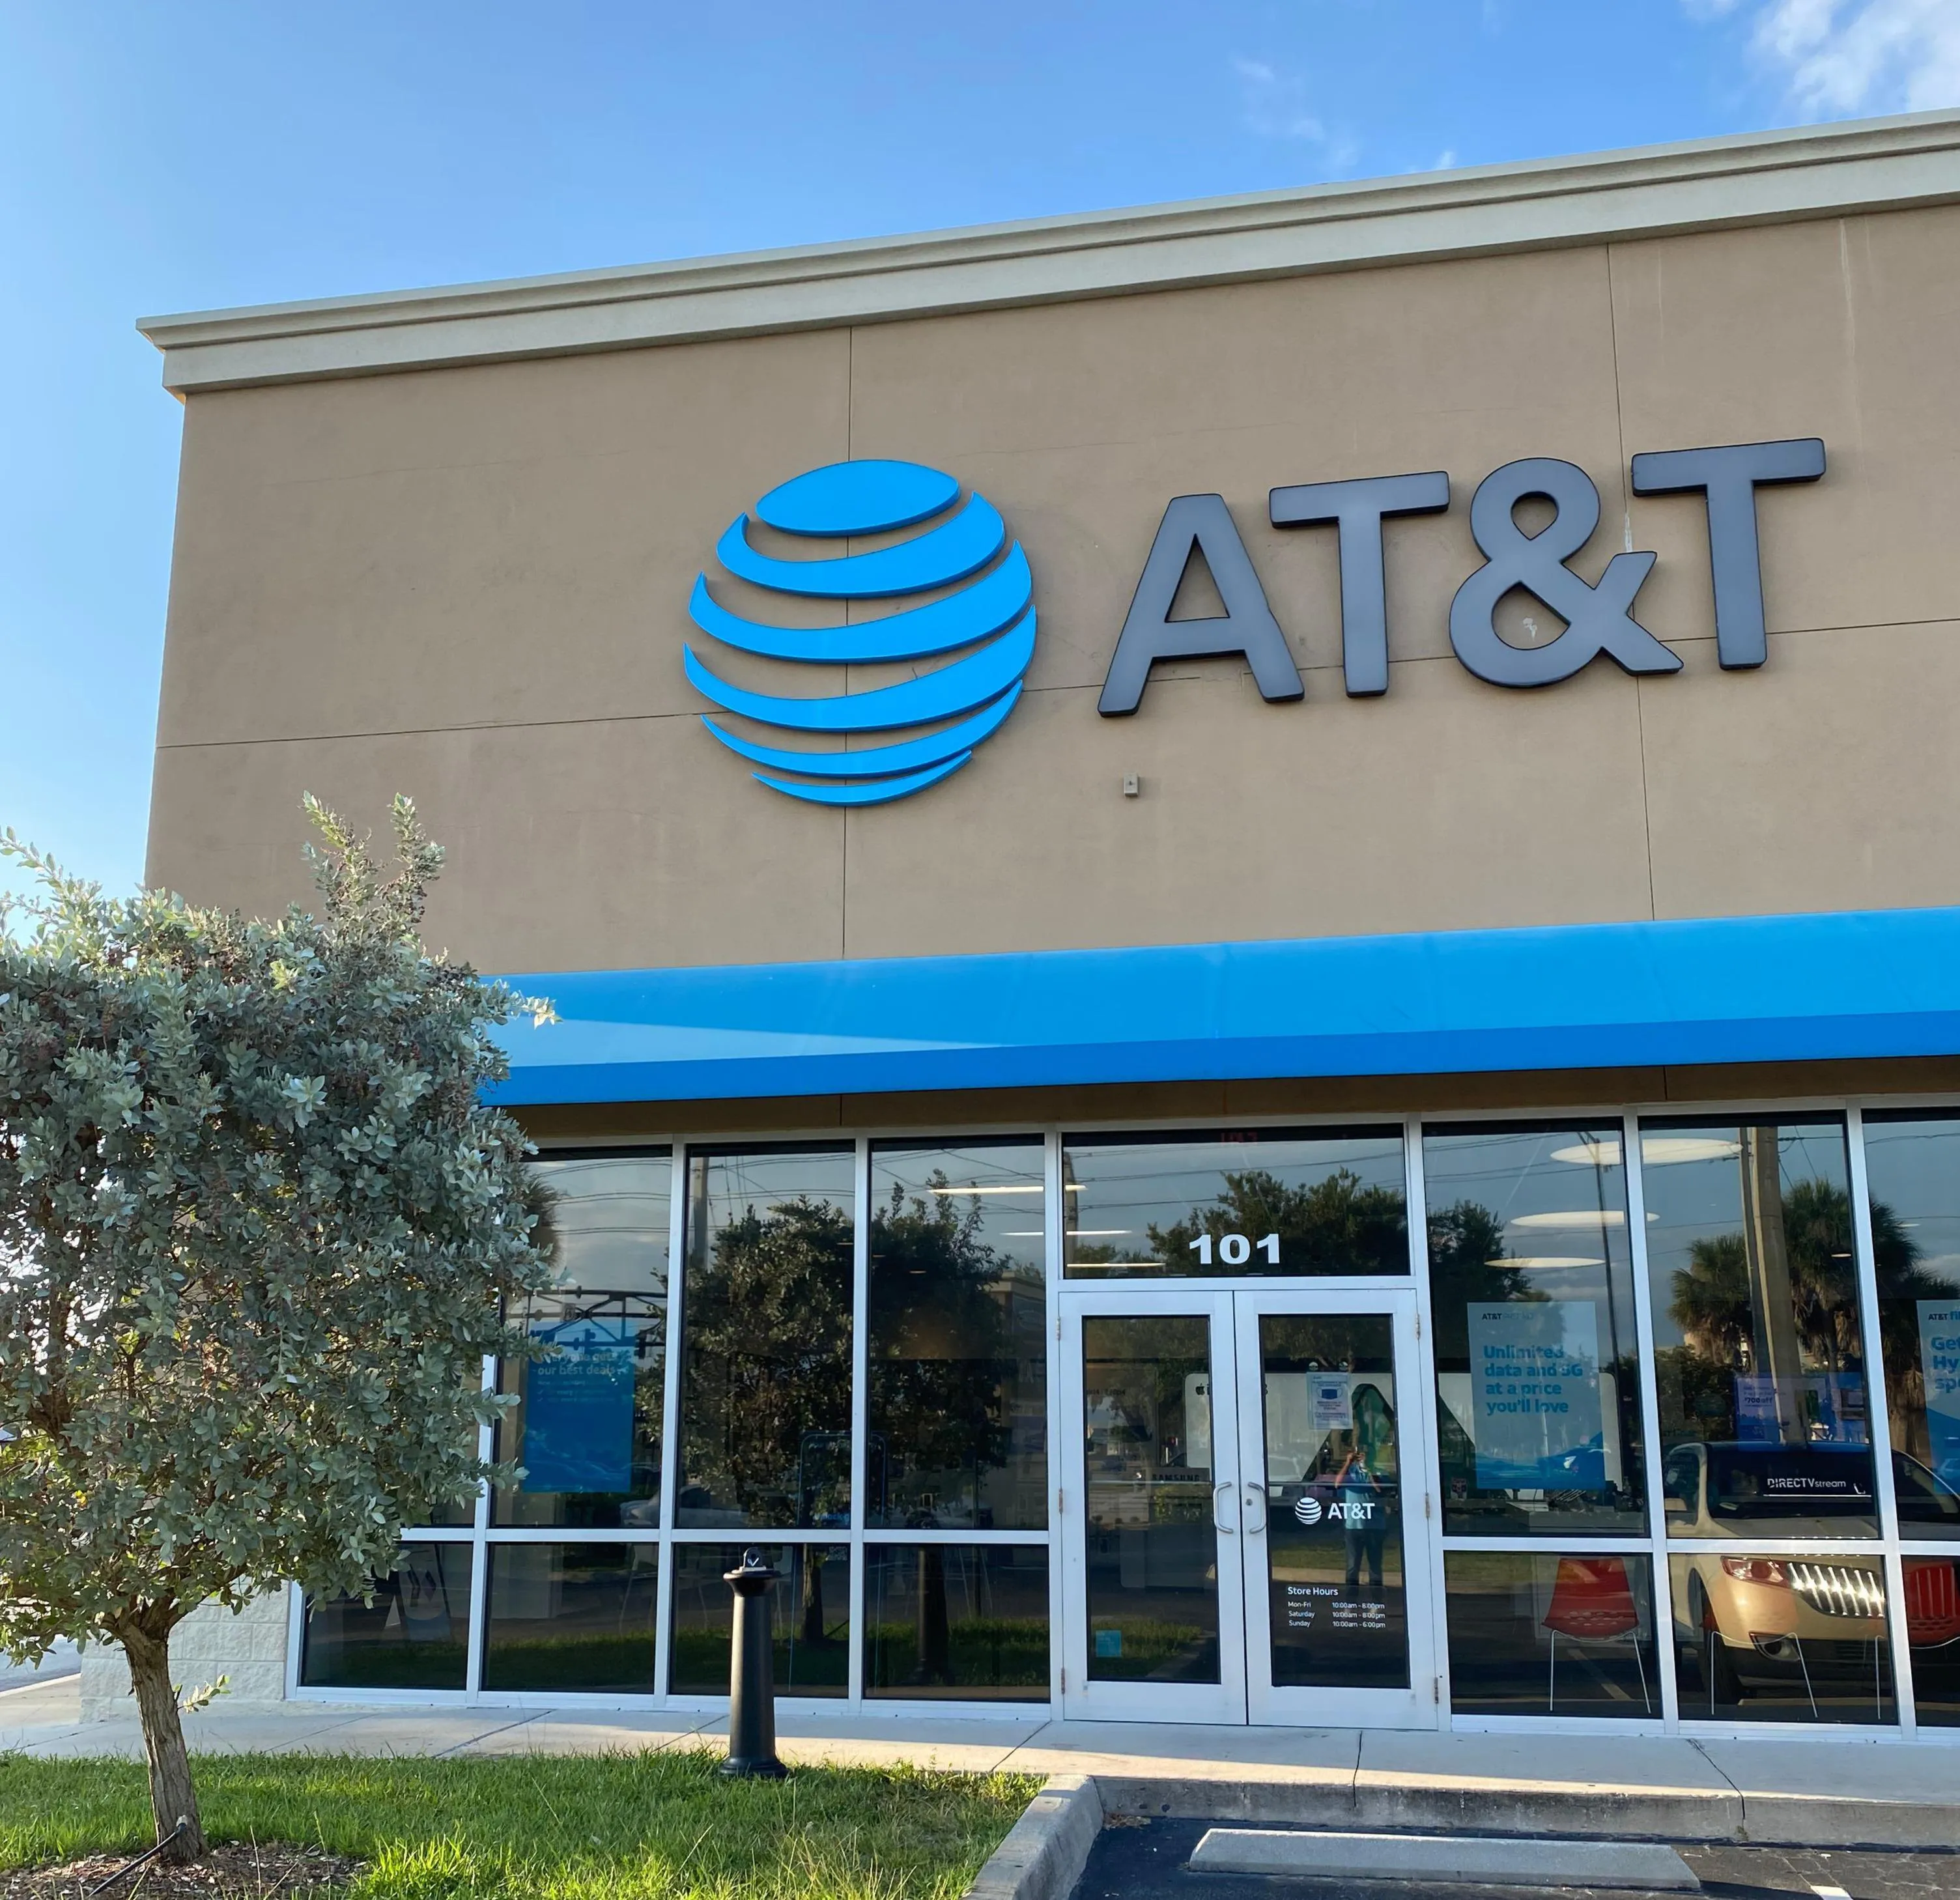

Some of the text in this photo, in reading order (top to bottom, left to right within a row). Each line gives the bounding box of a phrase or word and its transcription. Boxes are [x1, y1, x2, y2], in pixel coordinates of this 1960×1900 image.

[1098, 438, 1825, 717] AT&T
[1189, 1233, 1281, 1264] 101
[1484, 1345, 1564, 1359] Unlimited
[537, 1367, 556, 1375] our
[560, 1364, 584, 1375] best
[1484, 1363, 1522, 1377] data
[1527, 1363, 1557, 1377] and
[1486, 1382, 1561, 1398] at a price
[1935, 1378, 1960, 1393] sp
[1487, 1399, 1569, 1415] you'll love
[1328, 1503, 1376, 1519] AT&T
[1288, 1586, 1339, 1596] Store Hours
